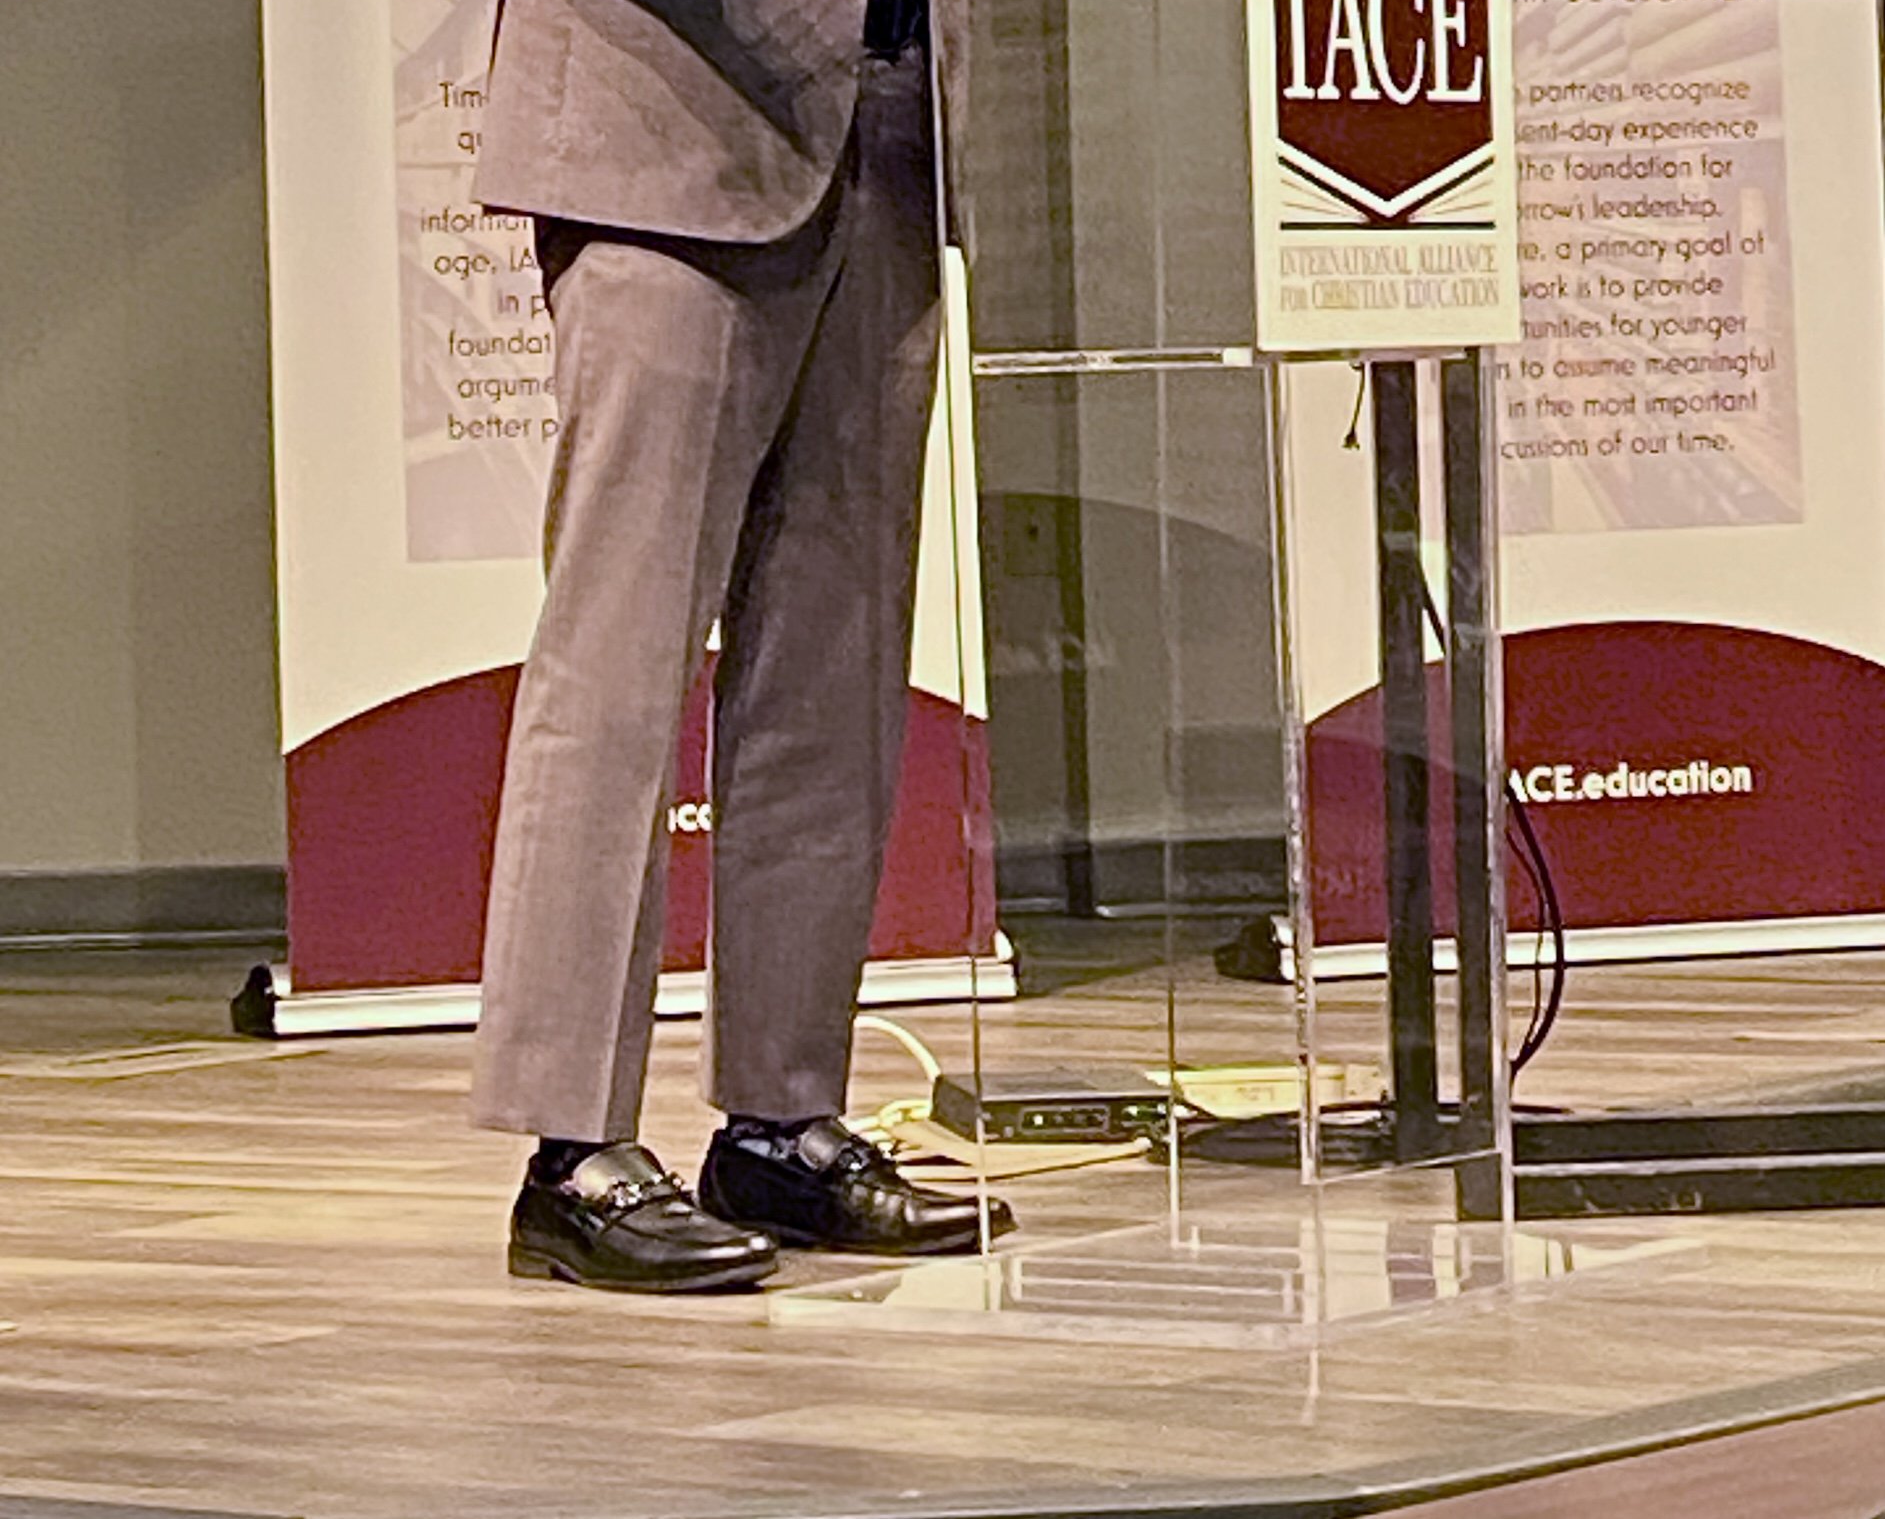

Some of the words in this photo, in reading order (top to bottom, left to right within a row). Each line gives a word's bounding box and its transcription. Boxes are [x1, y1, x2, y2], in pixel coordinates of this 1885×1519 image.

[1632, 79, 1750, 105] recognize
[1623, 117, 1758, 144] experience
[1564, 152, 1692, 181] foundation
[1701, 154, 1733, 178] for
[1582, 237, 1666, 264] primary
[1676, 230, 1732, 262] goal
[1740, 230, 1764, 256] of
[1600, 275, 1625, 298] to
[1634, 270, 1724, 300] provide
[1611, 313, 1643, 336] for
[1650, 314, 1748, 341] younger
[1520, 356, 1544, 378] to
[1645, 348, 1776, 377] meaningful
[1536, 395, 1574, 417] the
[1584, 393, 1636, 416] most
[1645, 389, 1759, 418] important
[448, 413, 531, 440] better
[1598, 430, 1623, 456] of
[1632, 435, 1668, 455] our
[1677, 431, 1736, 456] time.
